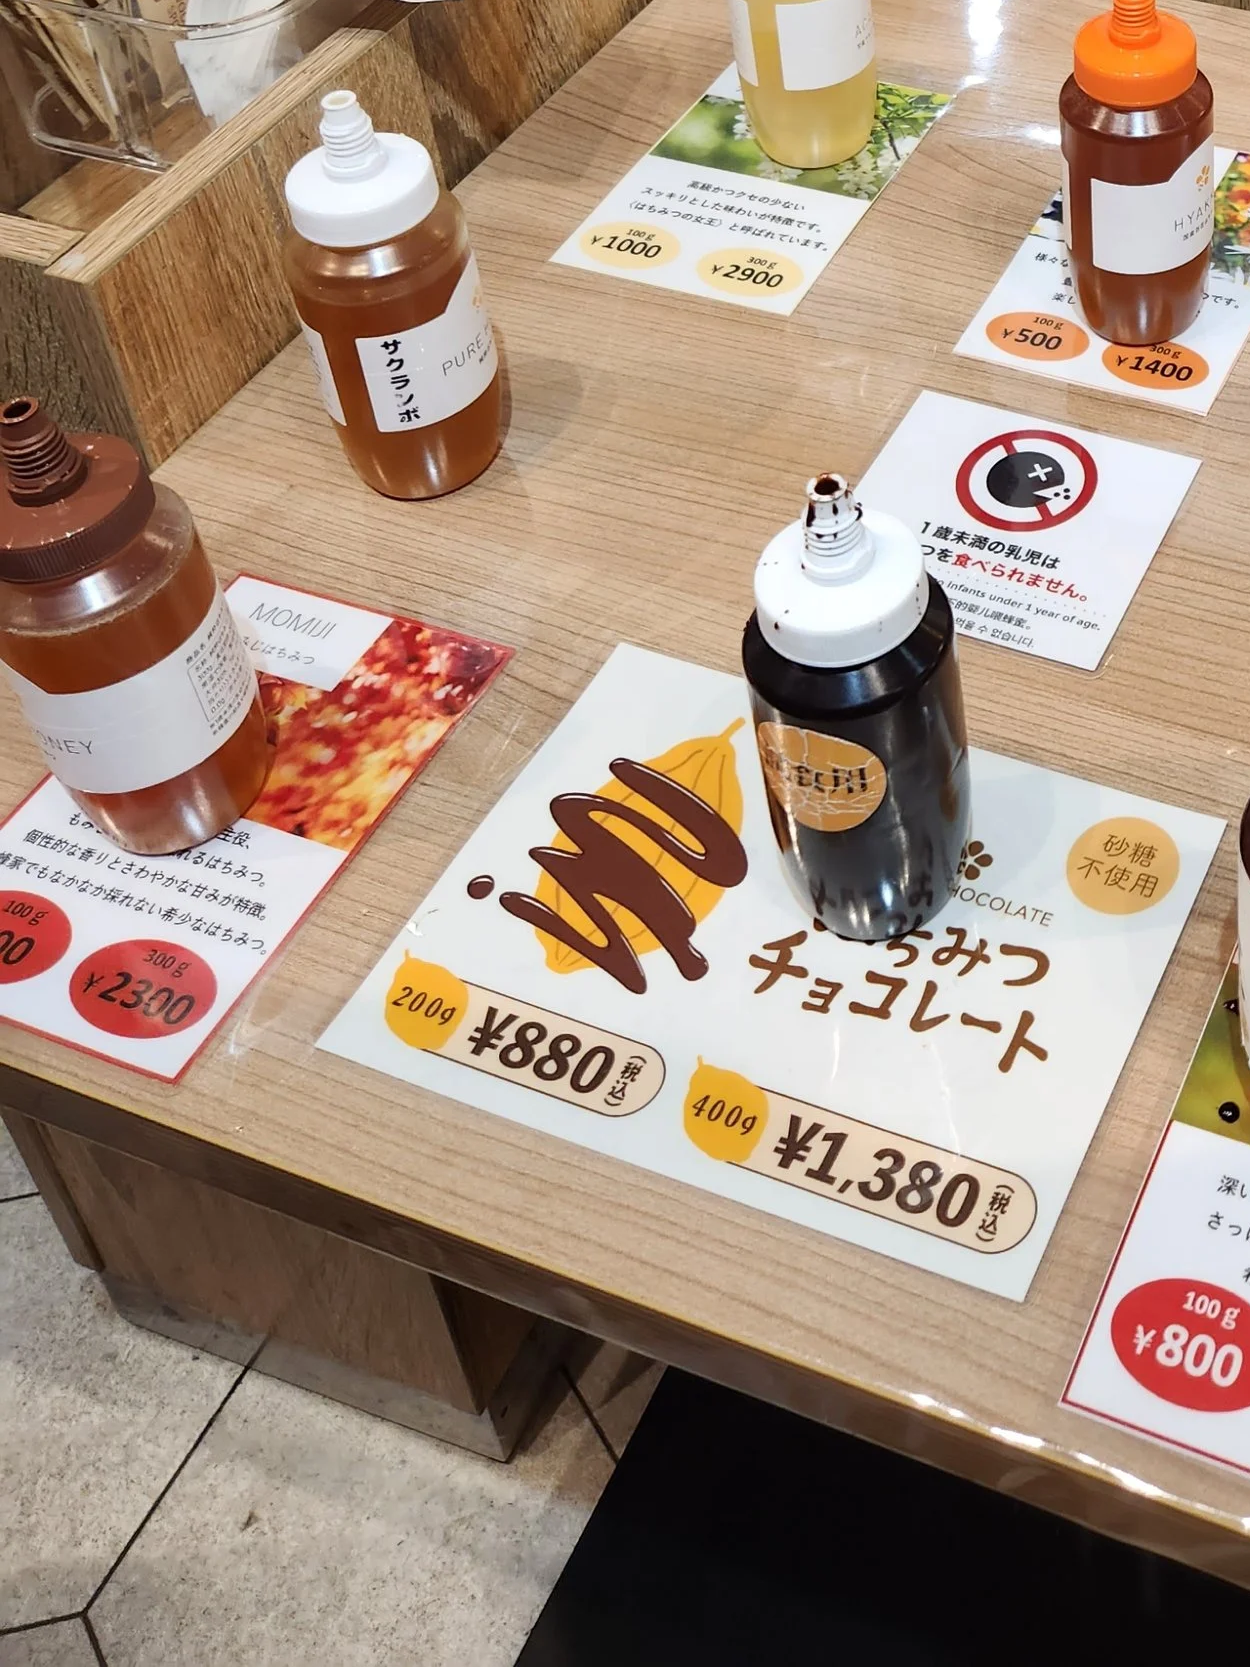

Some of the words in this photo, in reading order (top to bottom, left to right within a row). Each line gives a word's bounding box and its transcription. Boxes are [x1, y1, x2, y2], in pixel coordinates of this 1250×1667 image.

[640, 186, 823, 233] スッキリとした味わいが特徴です。
[686, 179, 807, 212] 高級かつクセの少ない
[442, 331, 484, 376] PURE
[379, 338, 422, 424] サクランボ
[920, 521, 1062, 570] 1歳未満の乳児は
[249, 602, 337, 640] MOMIJI
[988, 594, 1024, 611] under
[1033, 605, 1060, 620] year
[1062, 612, 1076, 624] of
[1076, 618, 1101, 632] age.
[1102, 833, 1160, 867] 砂糖
[1076, 857, 1159, 899] 不使用
[748, 929, 1049, 1074] チョコレート
[390, 986, 458, 1026] 200g
[691, 1094, 759, 1136] 400g
[467, 1005, 615, 1094] ¥880
[772, 1112, 981, 1230] ¥1,380
[1131, 1322, 1244, 1389] ¥800
